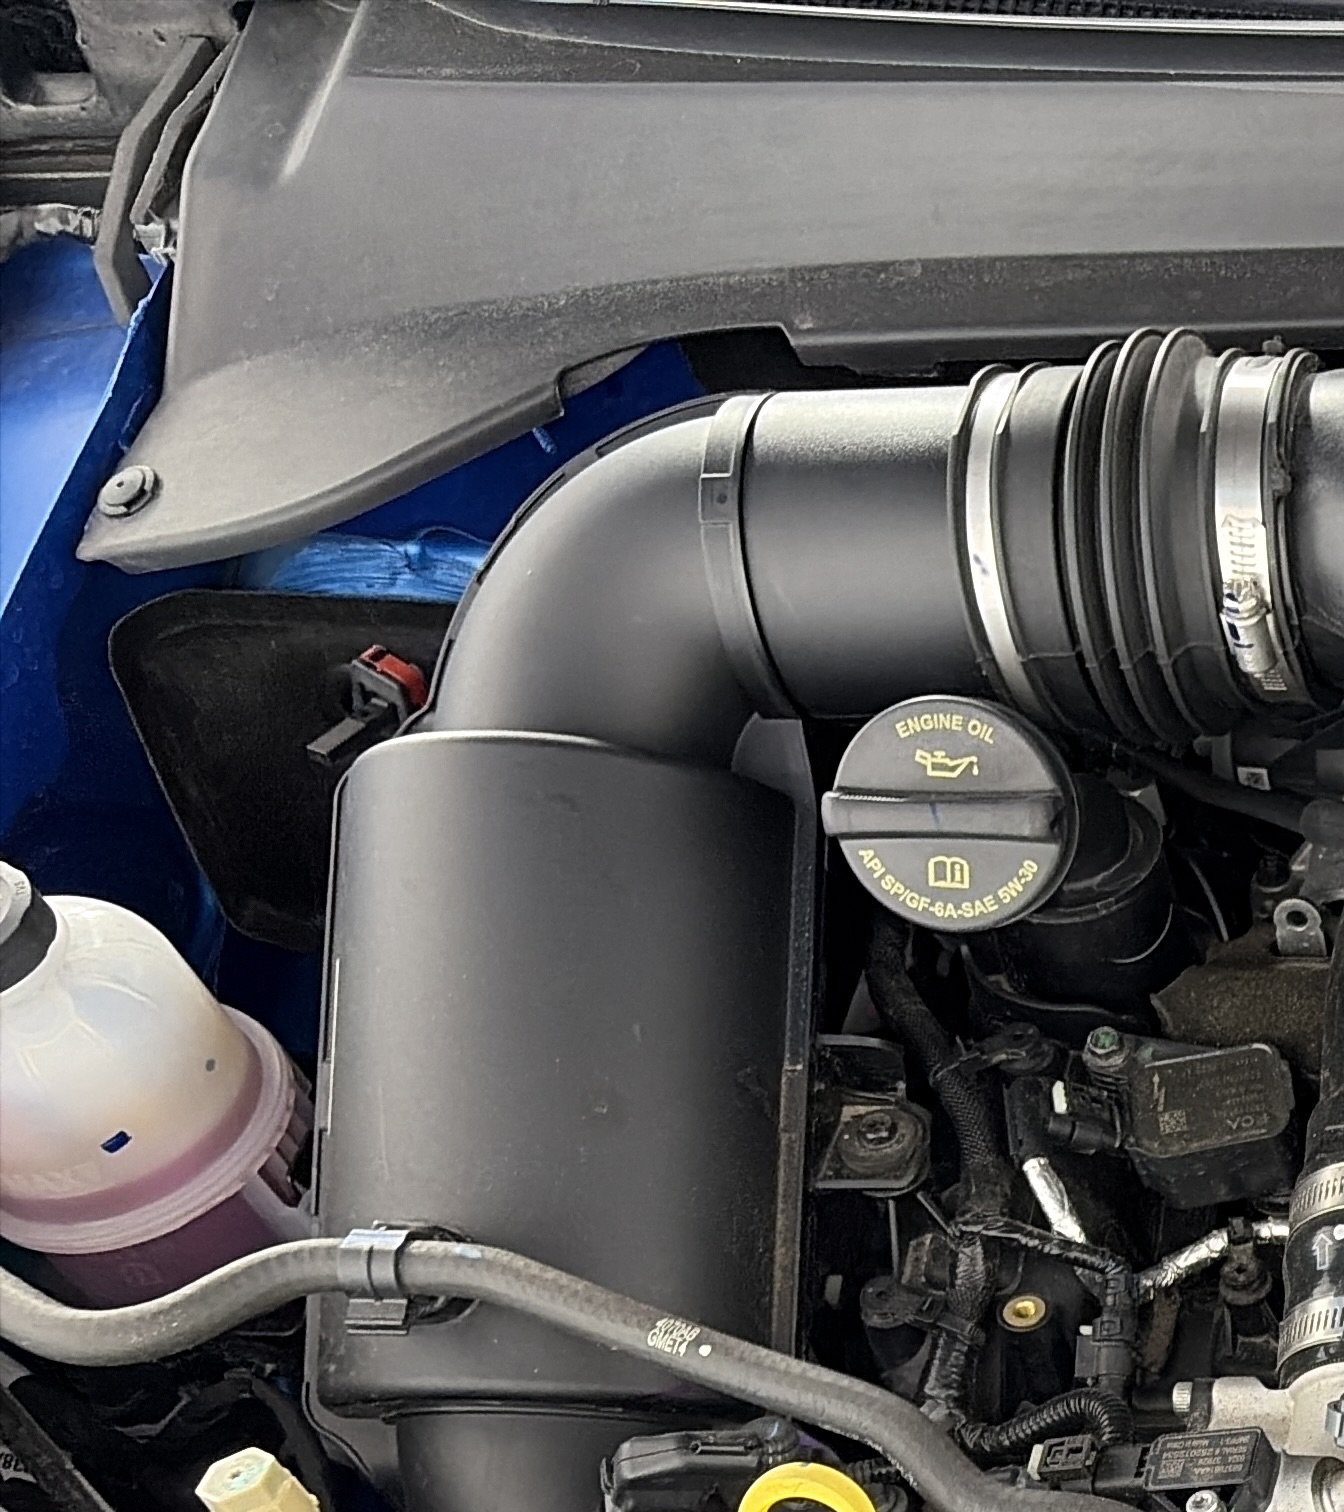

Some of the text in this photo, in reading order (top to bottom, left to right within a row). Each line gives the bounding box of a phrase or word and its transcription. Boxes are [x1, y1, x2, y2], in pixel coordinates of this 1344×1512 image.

[896, 713, 996, 745] ENGINE OIL
[858, 847, 882, 880] API
[998, 858, 1040, 905] 5W-30
